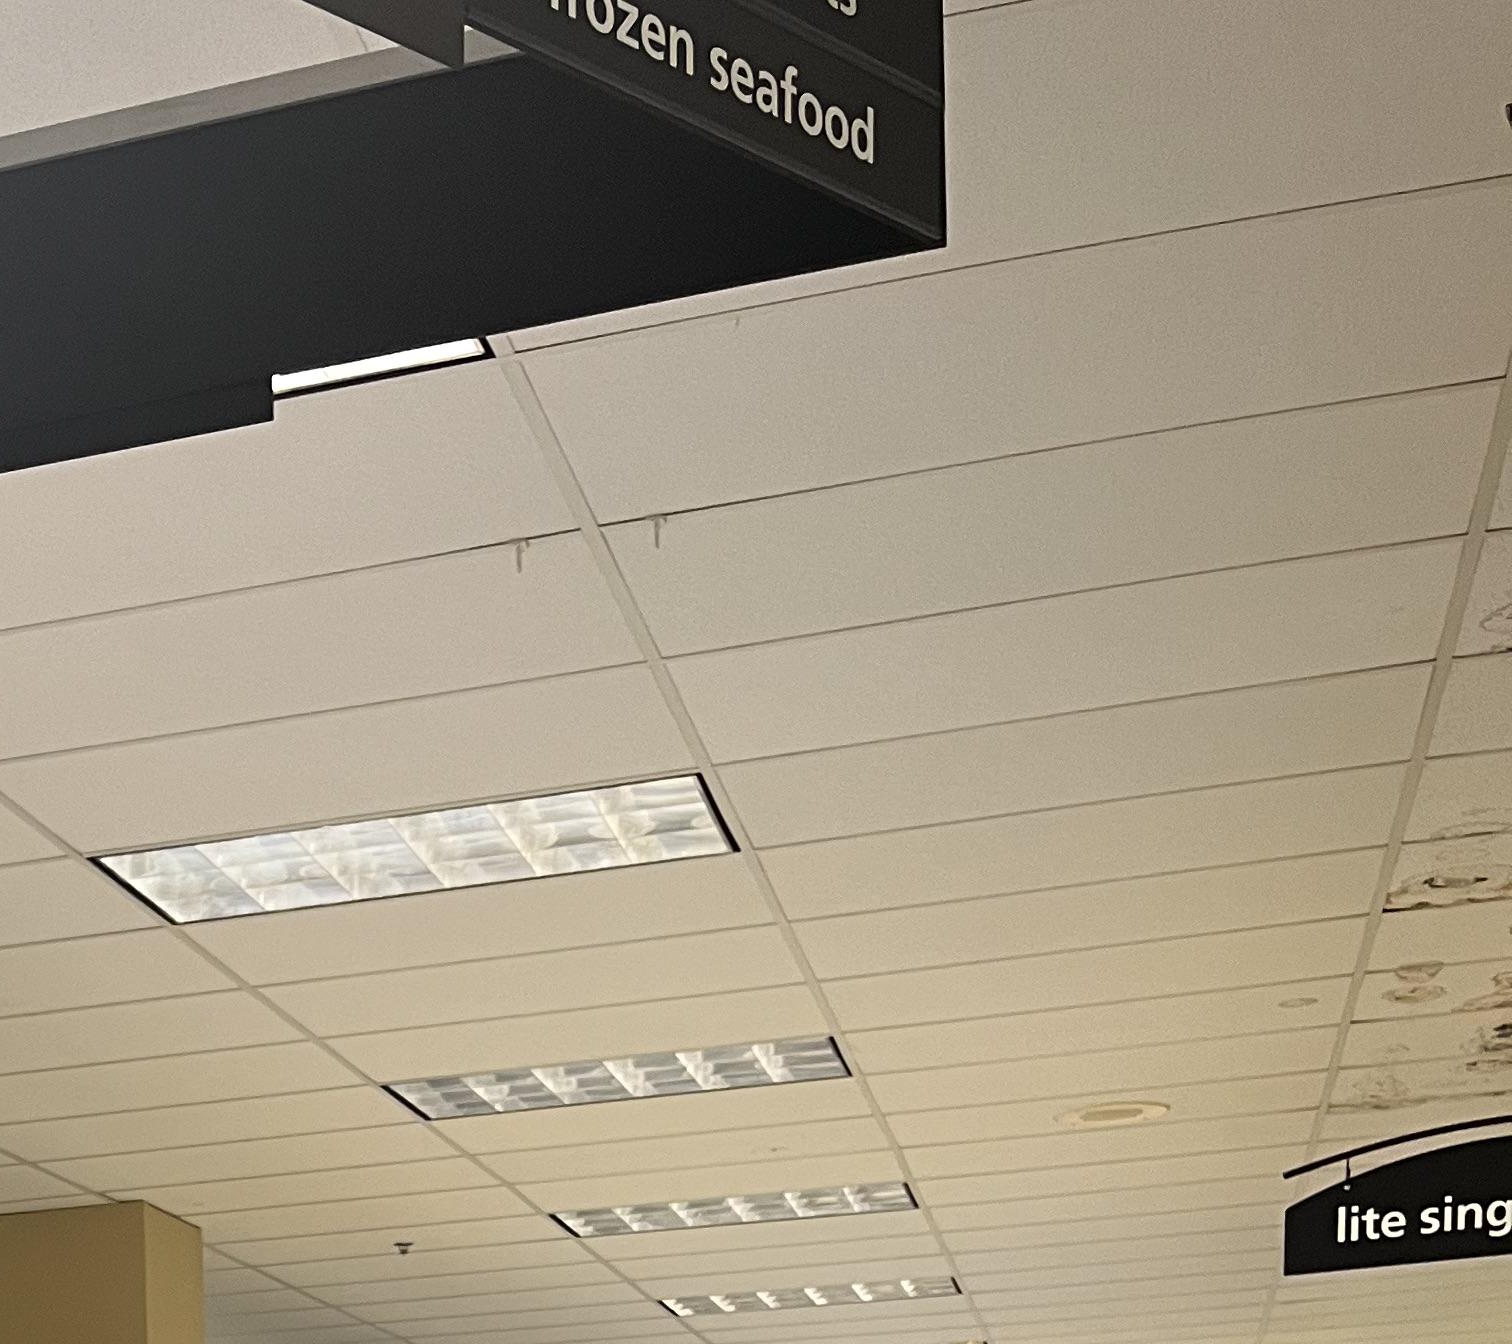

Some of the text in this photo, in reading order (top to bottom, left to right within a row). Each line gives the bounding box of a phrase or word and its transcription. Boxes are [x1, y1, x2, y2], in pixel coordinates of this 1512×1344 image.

[550, 0, 875, 164] ozen seafood
[1336, 1204, 1407, 1243] lite
